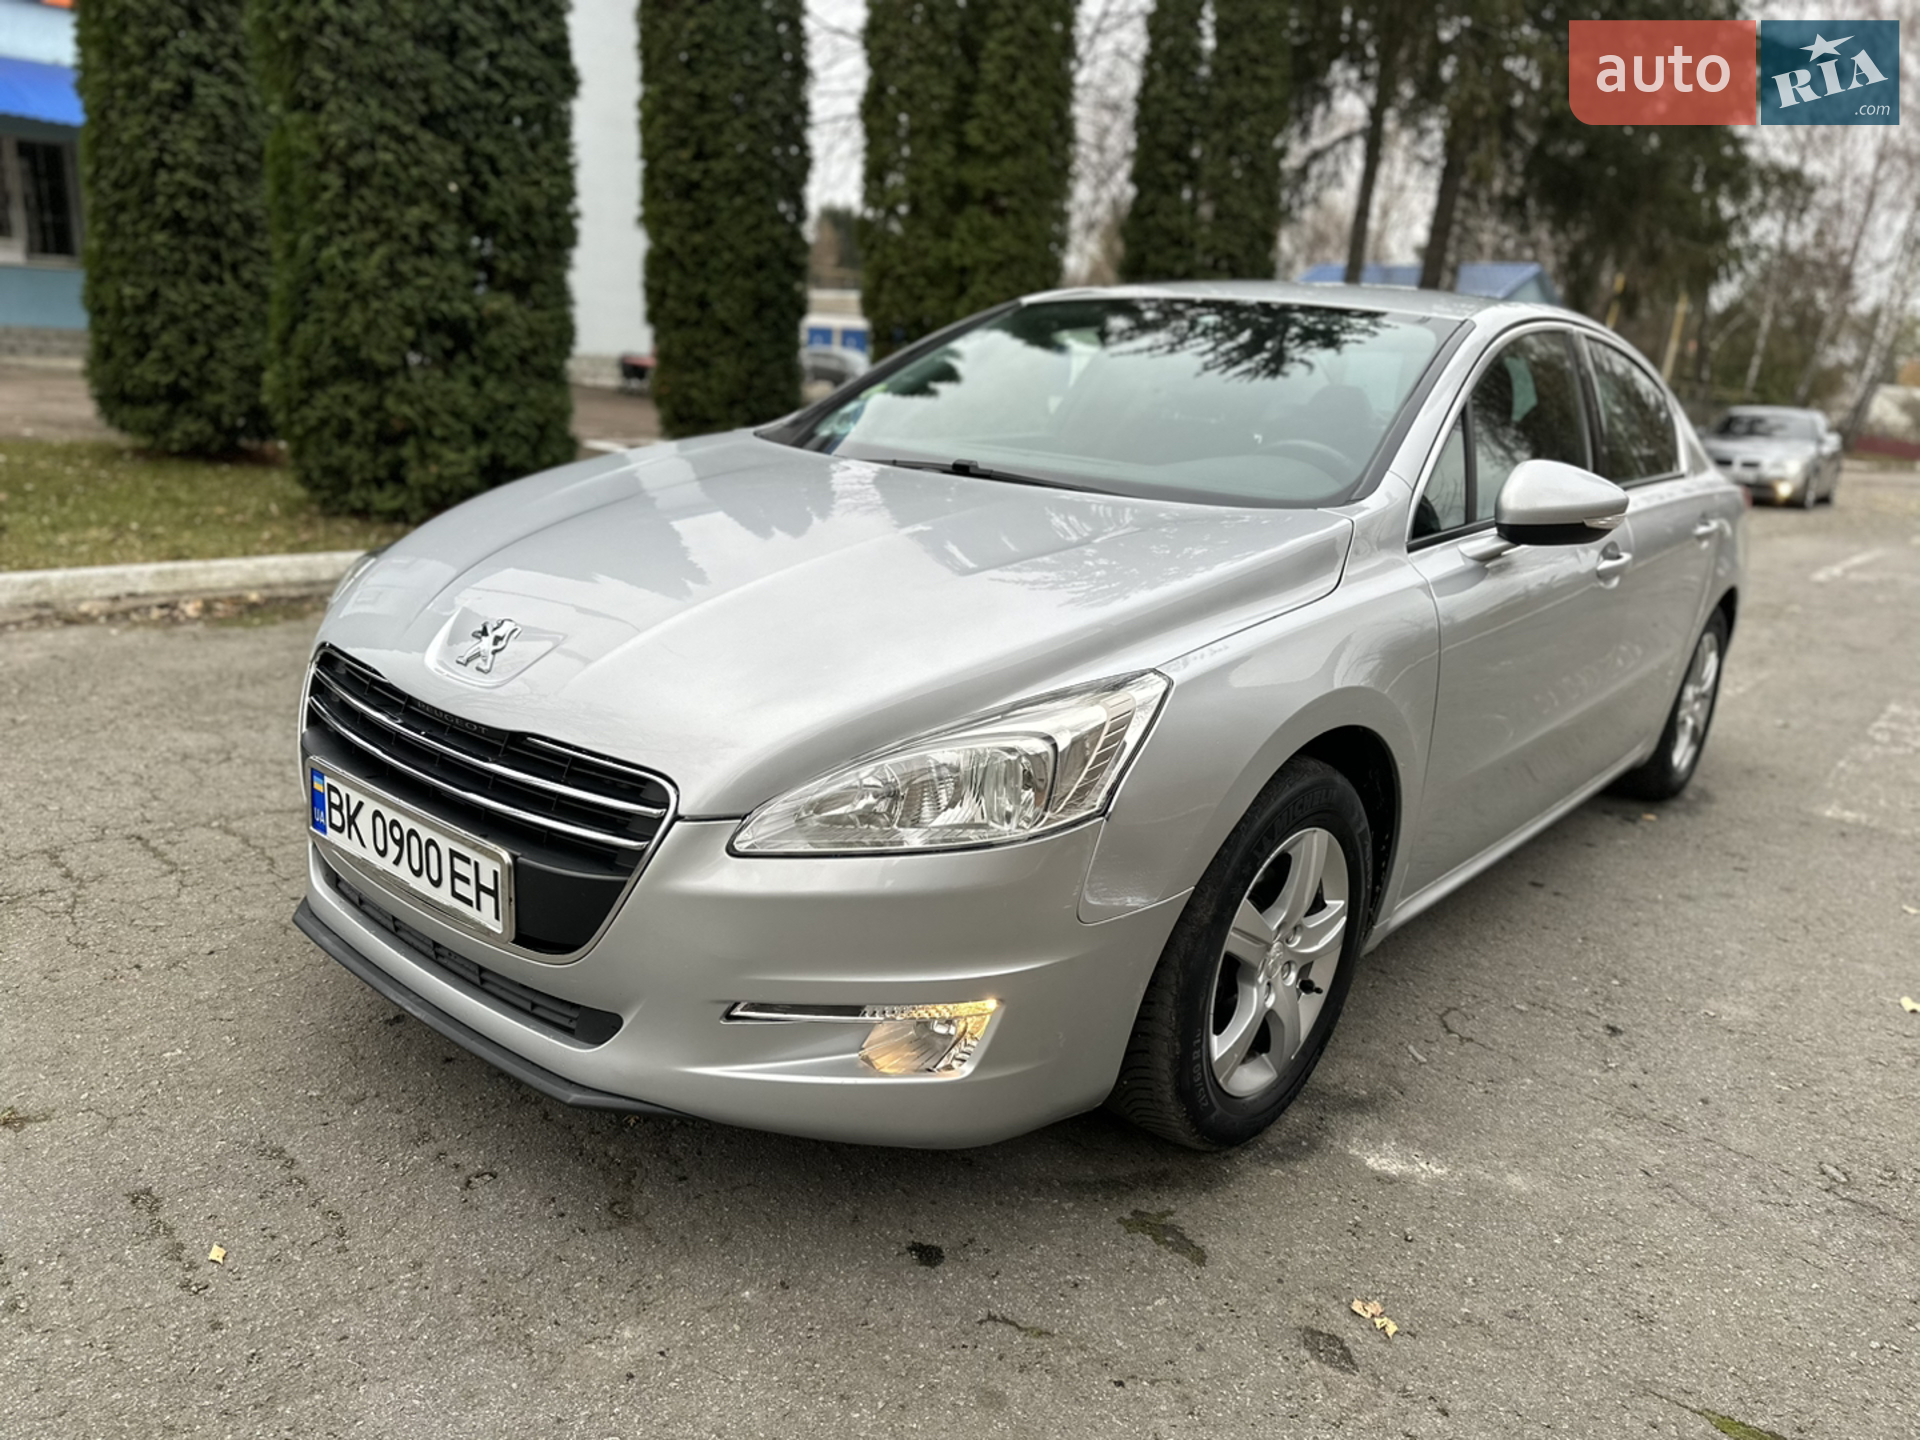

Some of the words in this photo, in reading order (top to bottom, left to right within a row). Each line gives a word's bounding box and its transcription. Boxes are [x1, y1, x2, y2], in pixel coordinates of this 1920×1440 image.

[314, 806, 326, 825] UA
[326, 782, 366, 849] BK
[371, 809, 443, 888] 0900
[448, 847, 501, 922] EH
[1192, 1063, 1209, 1111] 215/60
